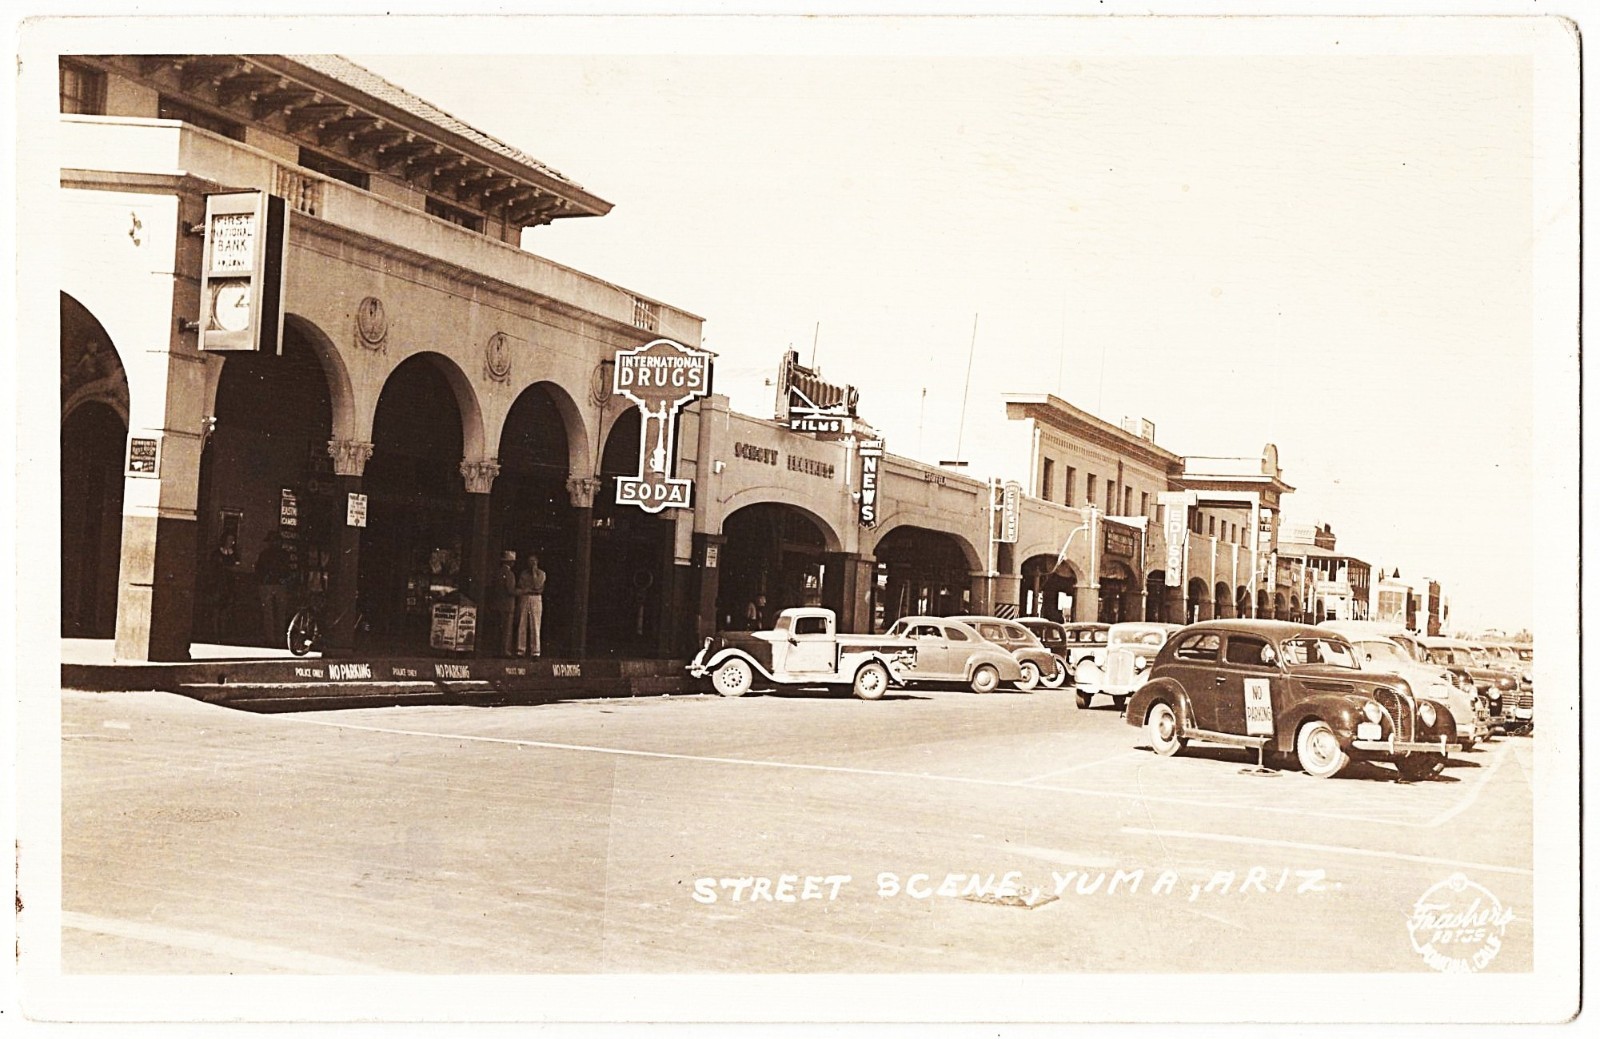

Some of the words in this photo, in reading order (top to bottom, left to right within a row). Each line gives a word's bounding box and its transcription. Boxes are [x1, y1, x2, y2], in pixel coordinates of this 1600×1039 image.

[216, 215, 250, 225] FIRST
[212, 228, 253, 237] NATIONAL
[217, 239, 247, 252] BANK
[621, 355, 704, 369] INTERNATIONAL
[621, 367, 701, 387] DRUGS
[791, 420, 839, 432] FILMS
[623, 482, 683, 502] SODA
[860, 456, 877, 521] NEWS
[1167, 509, 1182, 580] EDISON
[295, 667, 311, 677] POLICE
[312, 668, 324, 678] ONLY
[329, 664, 340, 680] NO
[341, 664, 371, 680] PARKING
[435, 664, 444, 678] NO
[444, 664, 470, 679] PARKING
[552, 664, 560, 677] NO
[560, 664, 581, 677] PARKING
[1252, 685, 1262, 700] NO
[1247, 706, 1271, 721] PARKING
